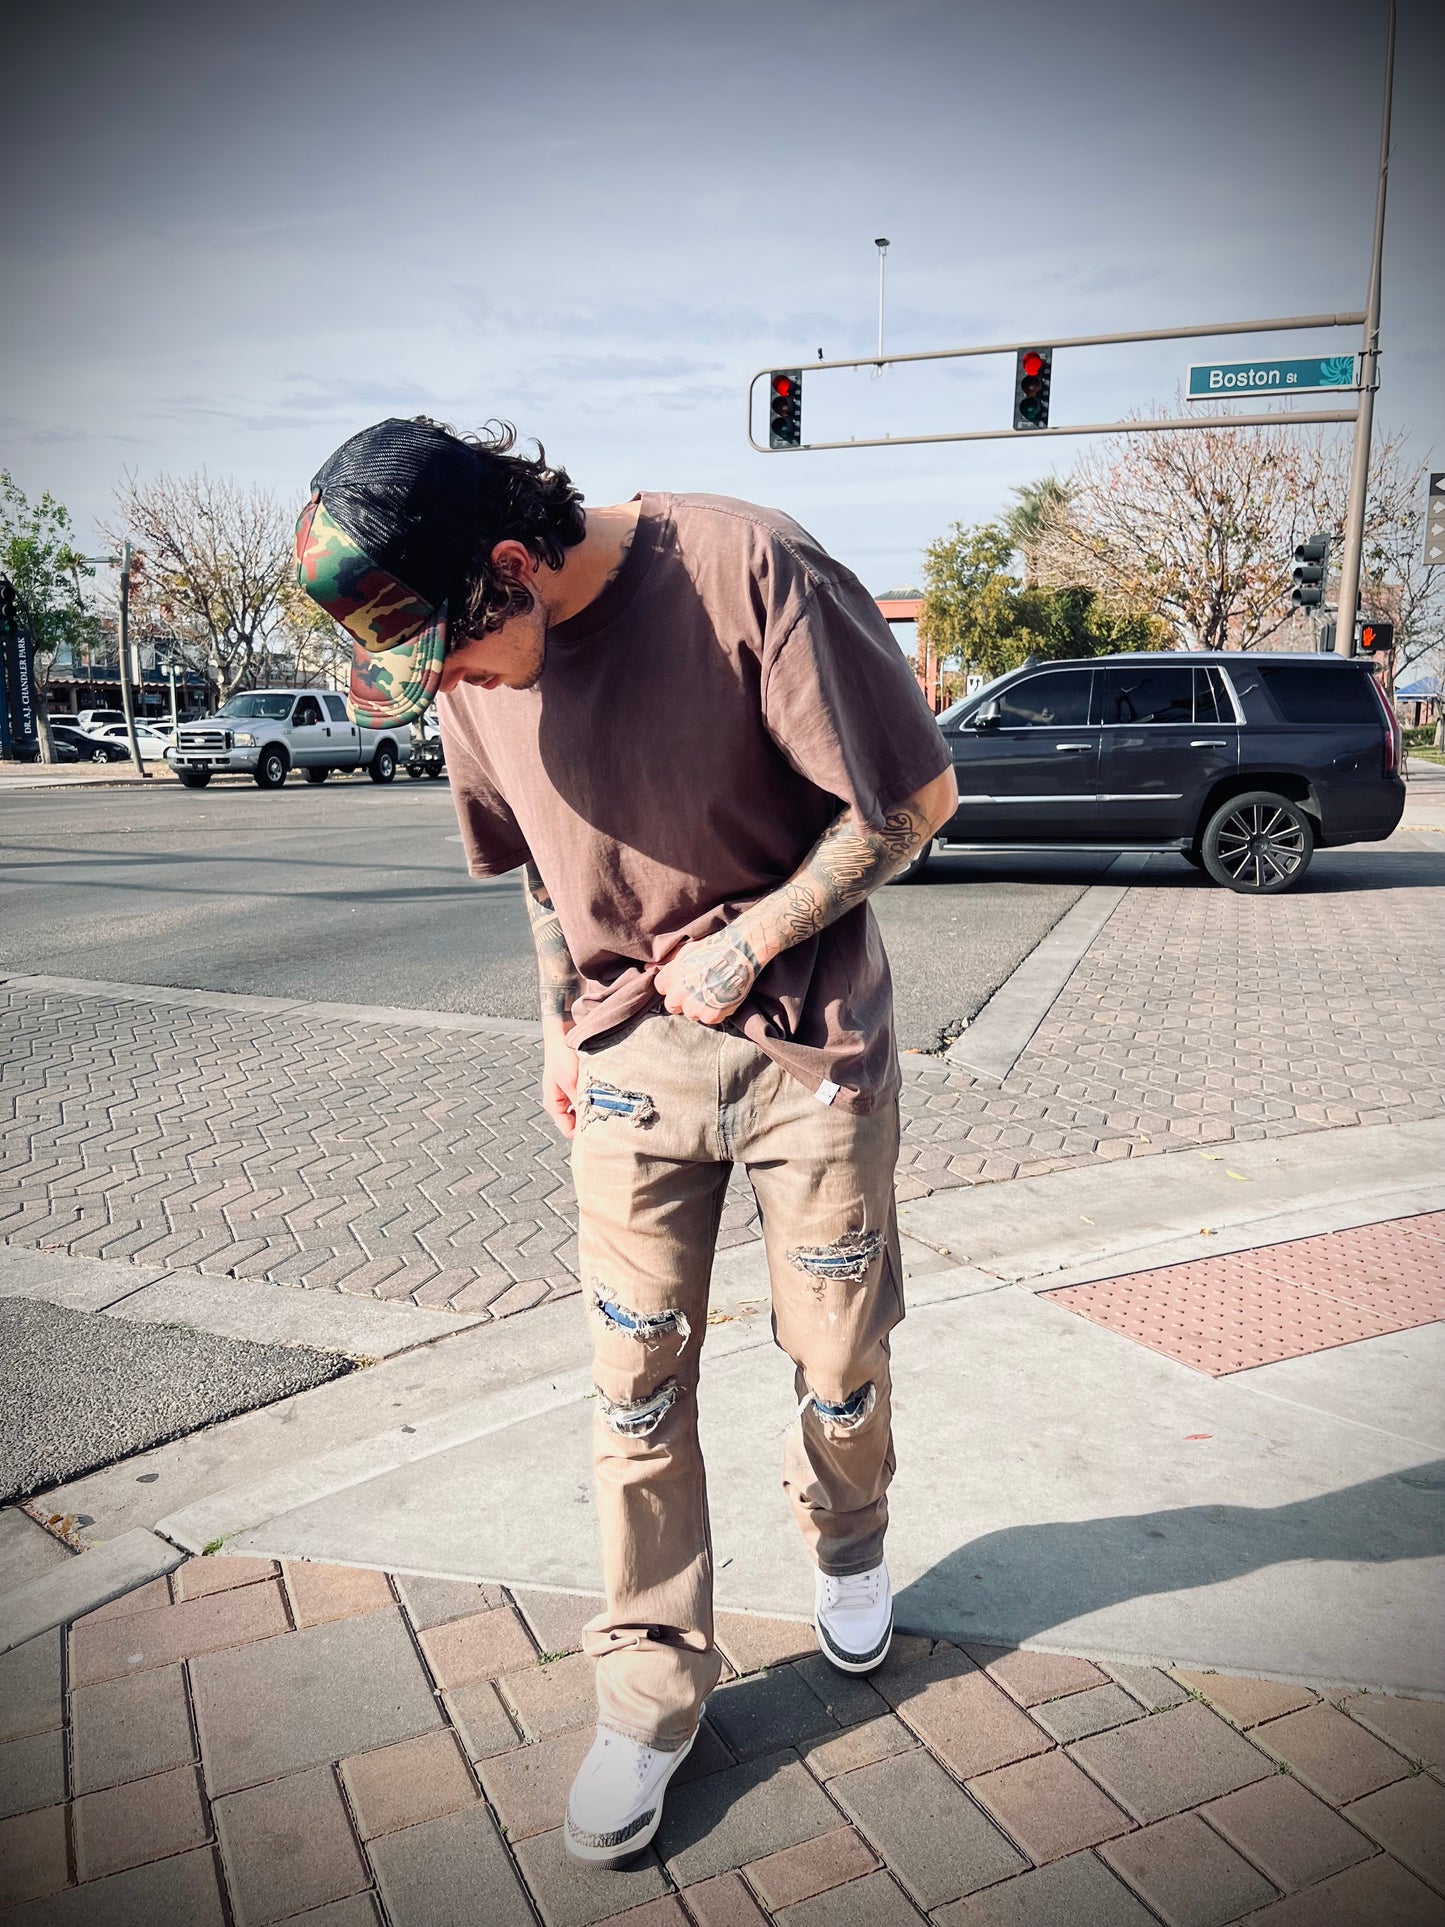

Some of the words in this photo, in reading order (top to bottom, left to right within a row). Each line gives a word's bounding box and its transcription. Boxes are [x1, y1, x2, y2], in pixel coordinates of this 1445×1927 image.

[1209, 368, 1280, 389] Boston
[1286, 372, 1298, 384] St
[17, 637, 27, 658] PARK
[19, 659, 30, 705] CHANDLER
[24, 720, 32, 734] DR.
